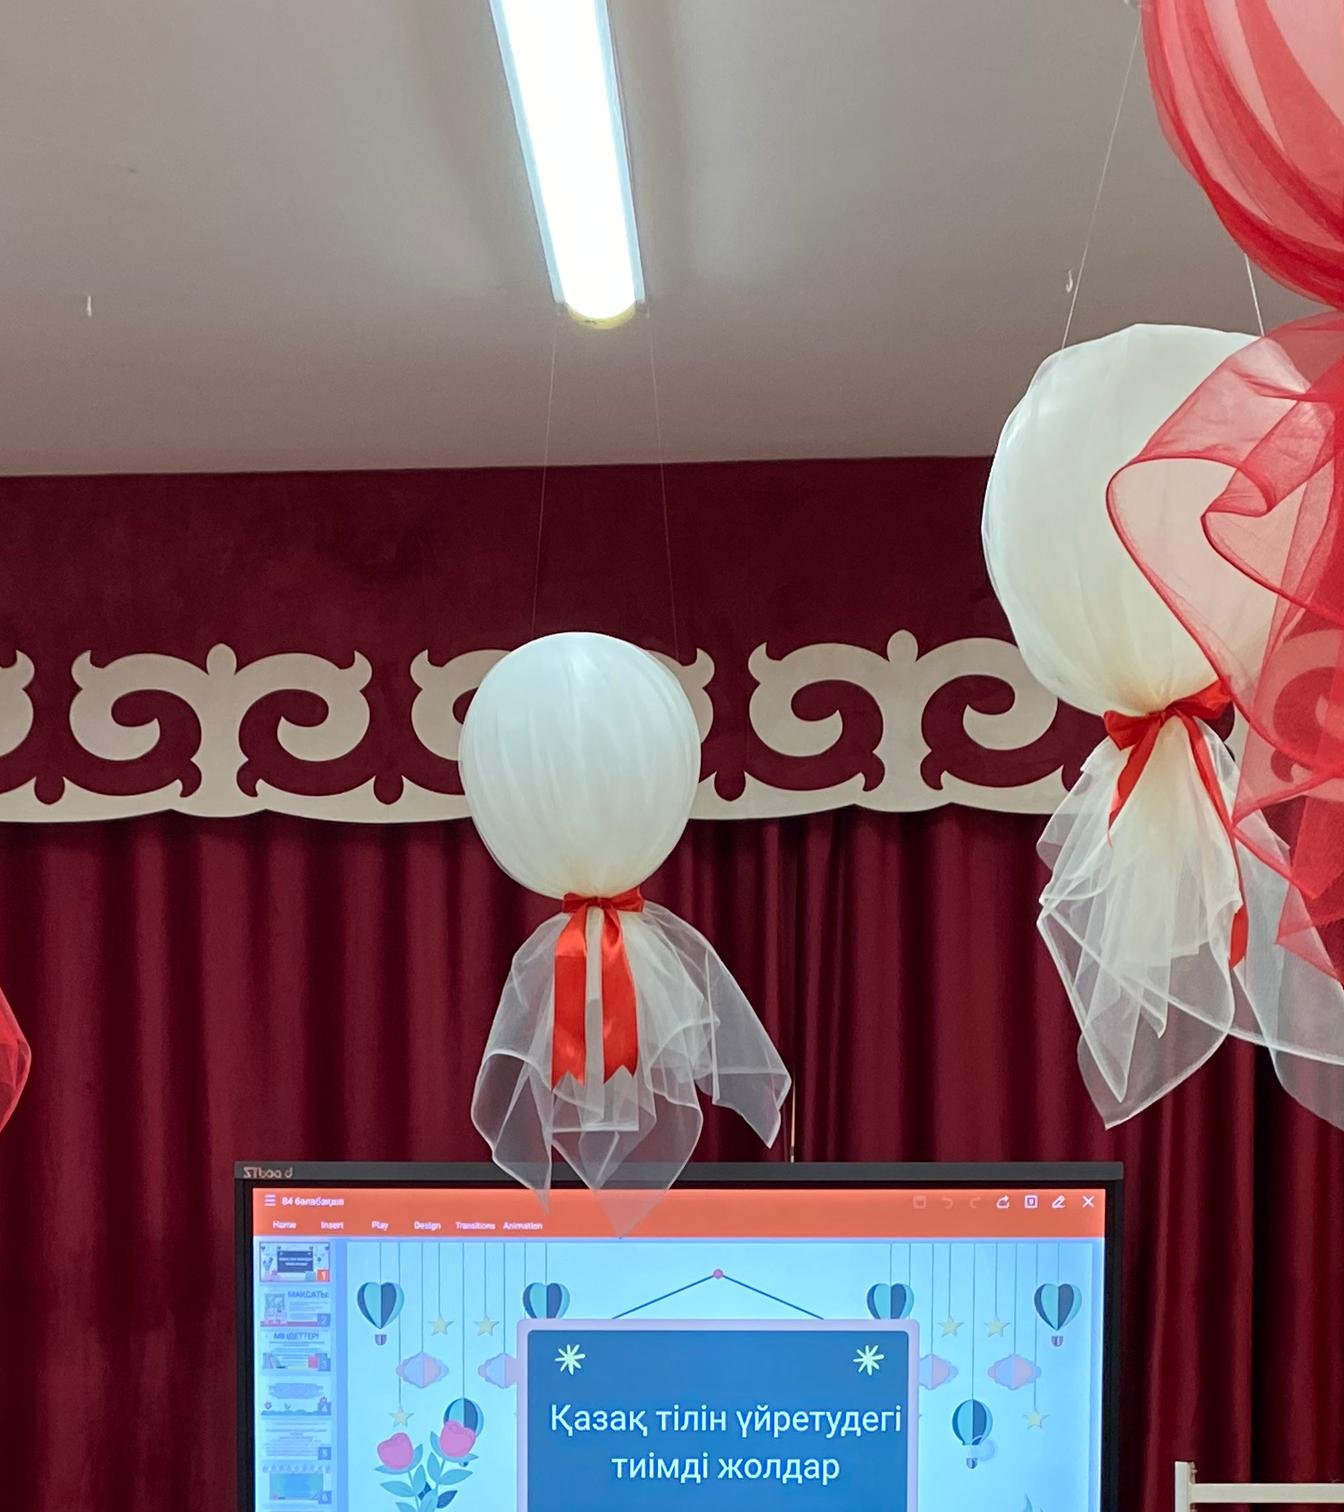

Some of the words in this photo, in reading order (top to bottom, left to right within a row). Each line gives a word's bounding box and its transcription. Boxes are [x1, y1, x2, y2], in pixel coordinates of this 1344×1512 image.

[272, 1220, 297, 1230] Home
[320, 1220, 344, 1230] Insert
[371, 1220, 389, 1232] Play
[414, 1221, 441, 1232] Design
[455, 1221, 496, 1230] Transitions
[503, 1221, 543, 1230] Animation
[550, 1403, 648, 1437] Қазақ
[656, 1404, 727, 1432] тілін
[735, 1404, 902, 1438] үйретудегі
[611, 1452, 709, 1484] тиімді
[717, 1457, 841, 1485] жолдар
